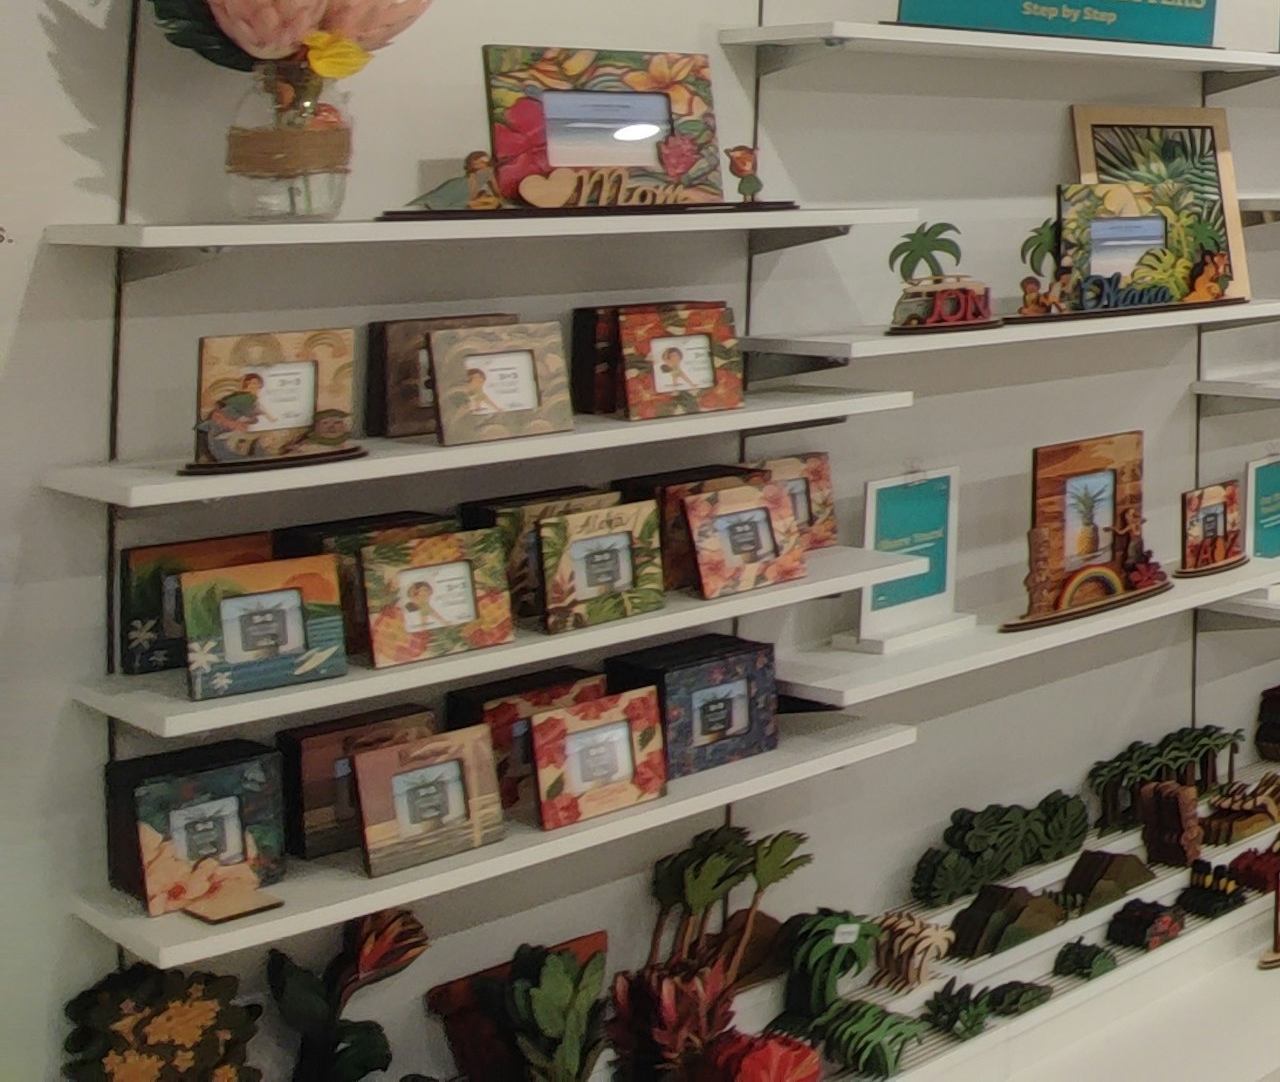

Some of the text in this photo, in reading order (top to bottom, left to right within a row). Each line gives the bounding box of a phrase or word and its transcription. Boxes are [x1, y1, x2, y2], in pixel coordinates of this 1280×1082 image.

[1022, 1, 1117, 25] Step by Step
[576, 167, 686, 207] Mom
[926, 287, 991, 325] JON
[1080, 273, 1172, 311] Ohana
